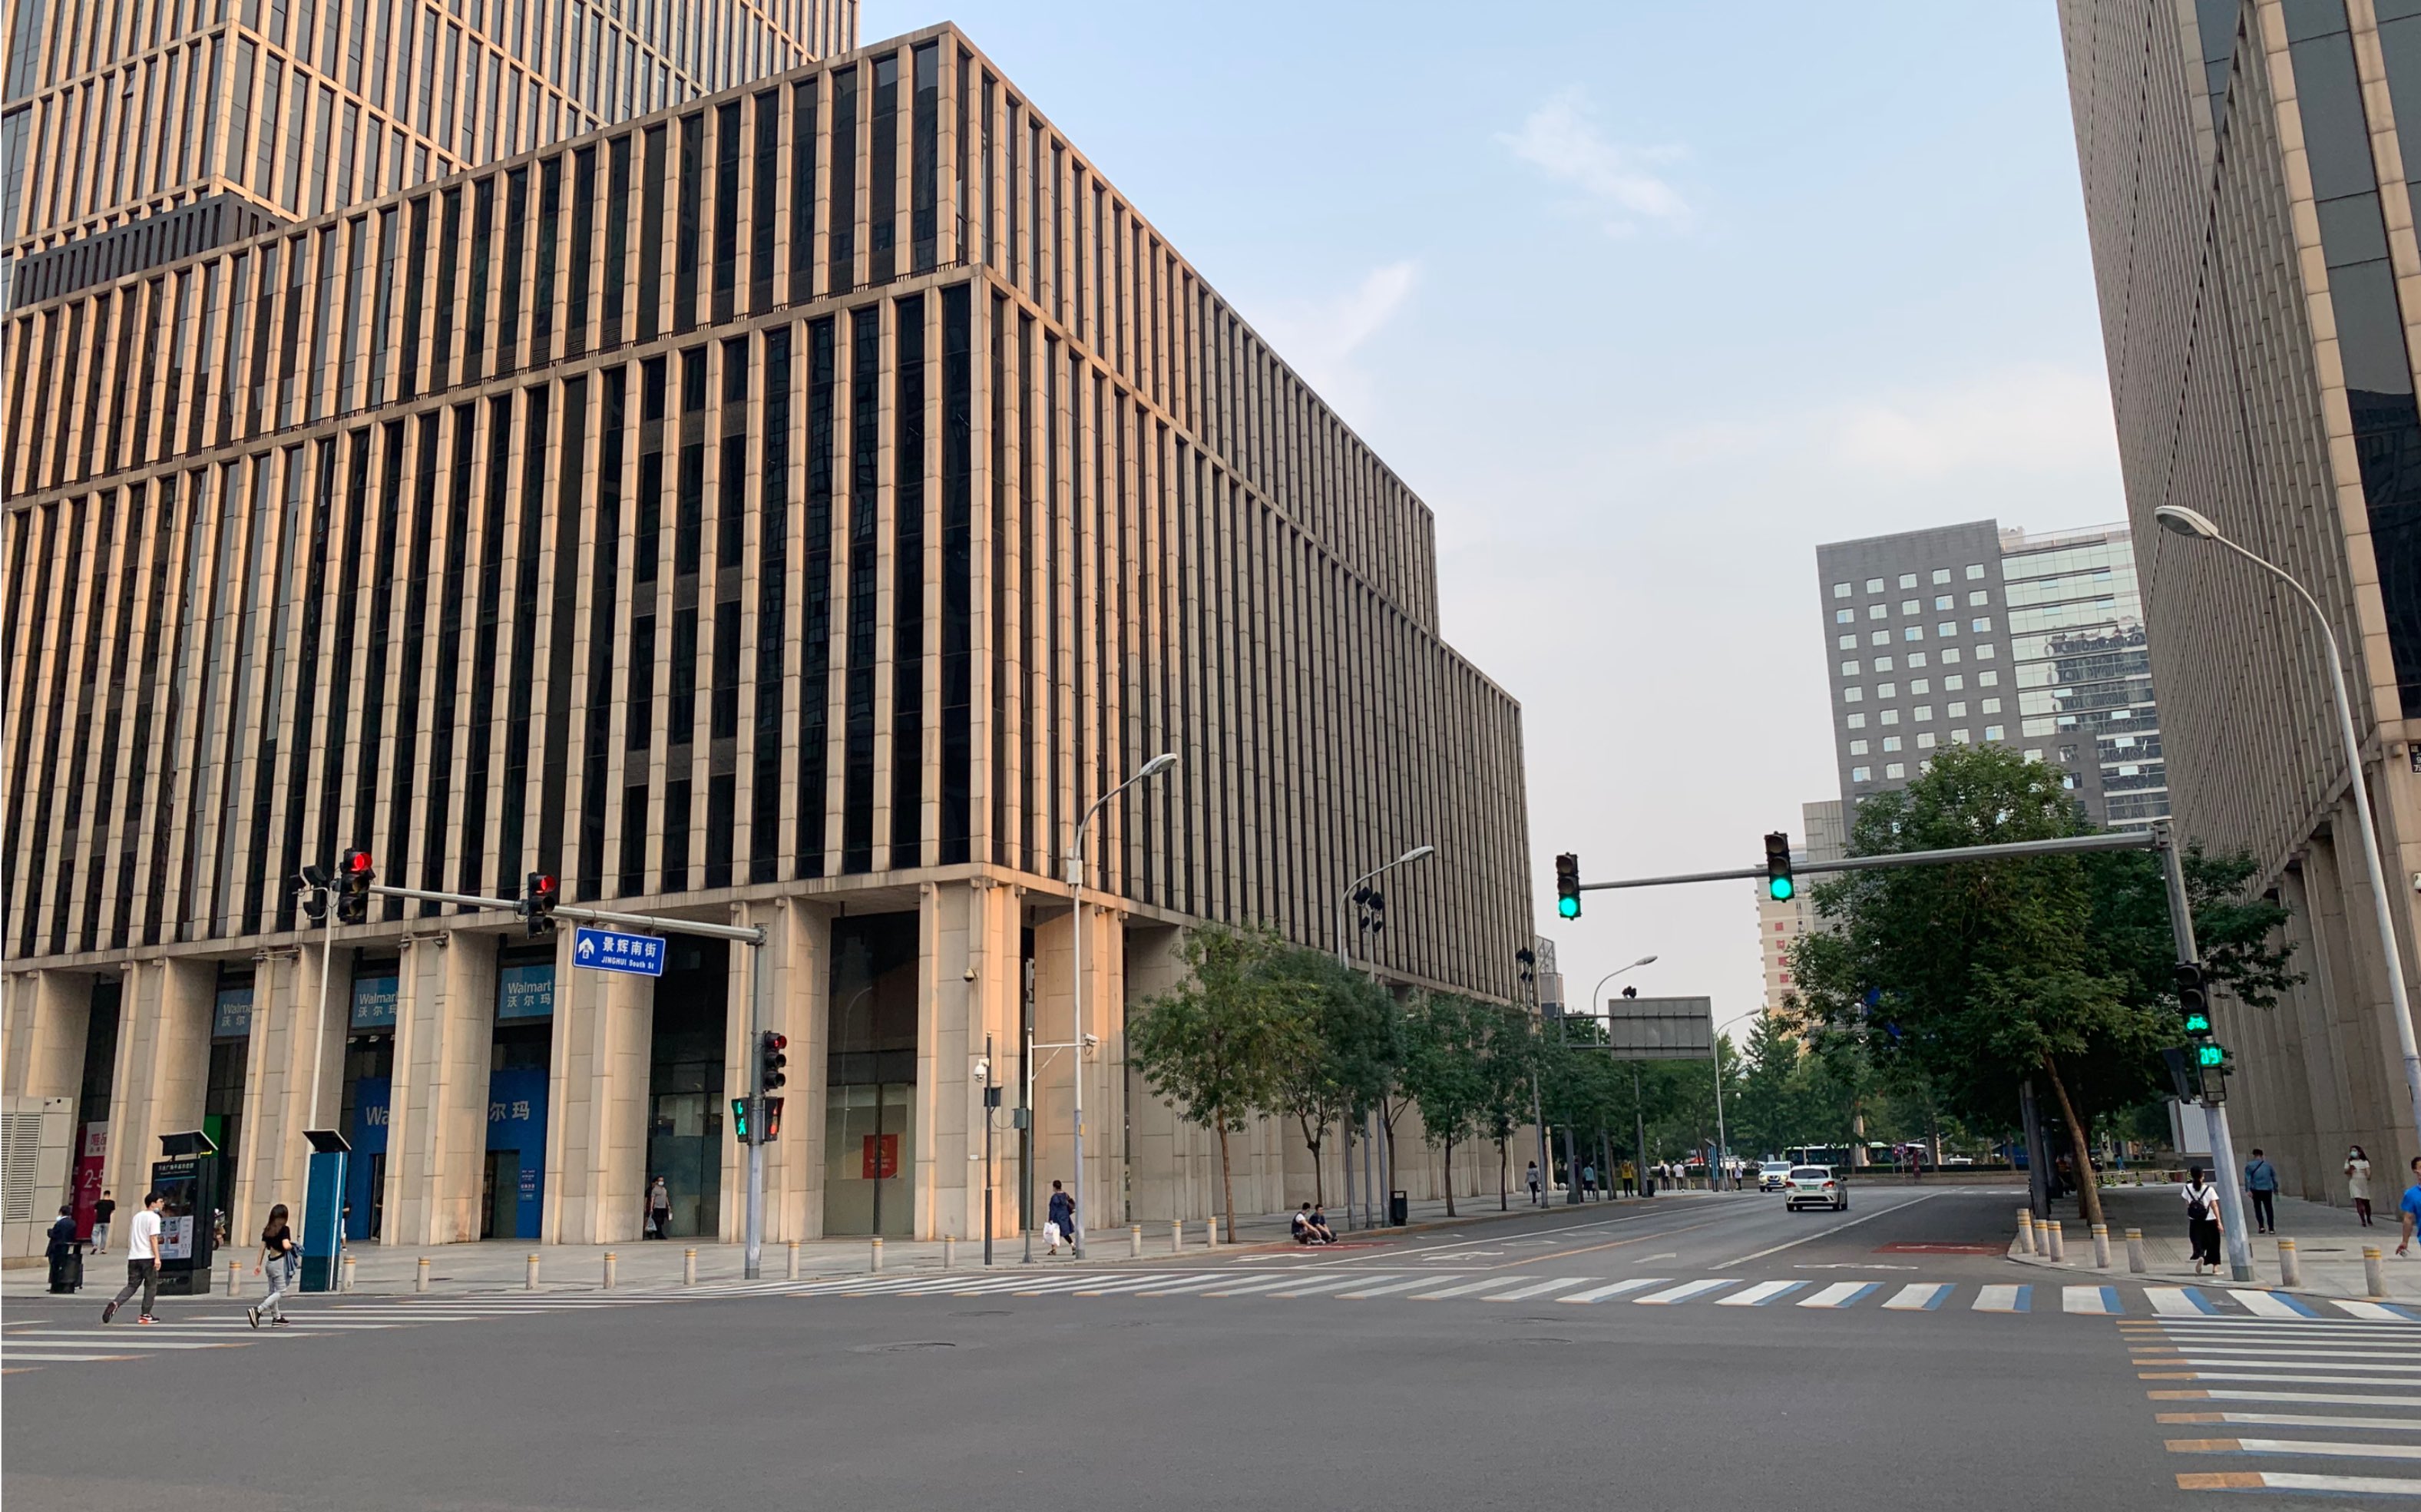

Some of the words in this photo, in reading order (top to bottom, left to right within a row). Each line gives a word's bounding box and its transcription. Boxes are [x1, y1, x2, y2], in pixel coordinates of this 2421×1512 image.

[602, 936, 657, 958] 景辉南街
[601, 956, 627, 966] JINGHUI
[629, 959, 645, 968] South
[647, 961, 654, 970] St
[508, 979, 551, 994] Walmart
[507, 994, 551, 1007] 沃尔玛
[489, 1100, 530, 1122] 尔玛
